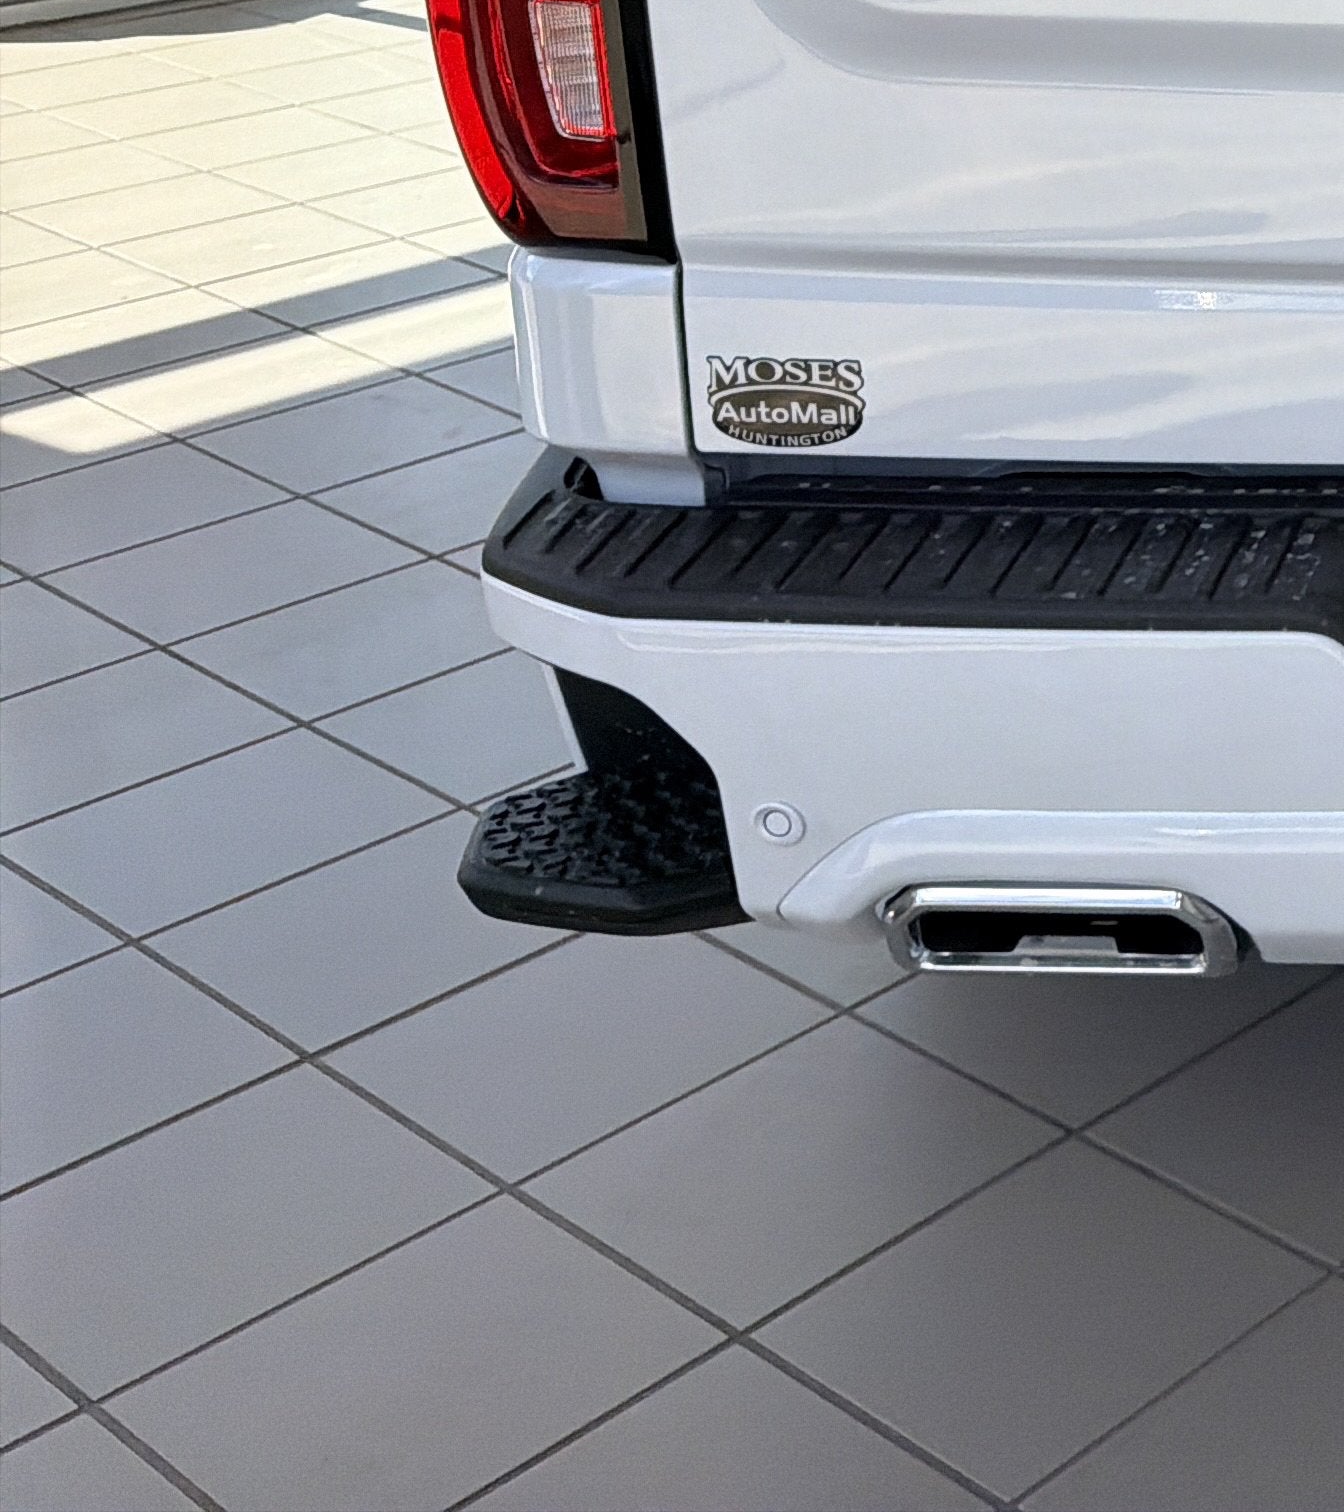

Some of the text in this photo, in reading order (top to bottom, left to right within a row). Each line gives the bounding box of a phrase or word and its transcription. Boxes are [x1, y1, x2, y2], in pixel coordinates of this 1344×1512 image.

[707, 356, 864, 392] MOSES
[717, 401, 858, 426] AutoMall
[728, 424, 848, 447] HUNTINGTON
